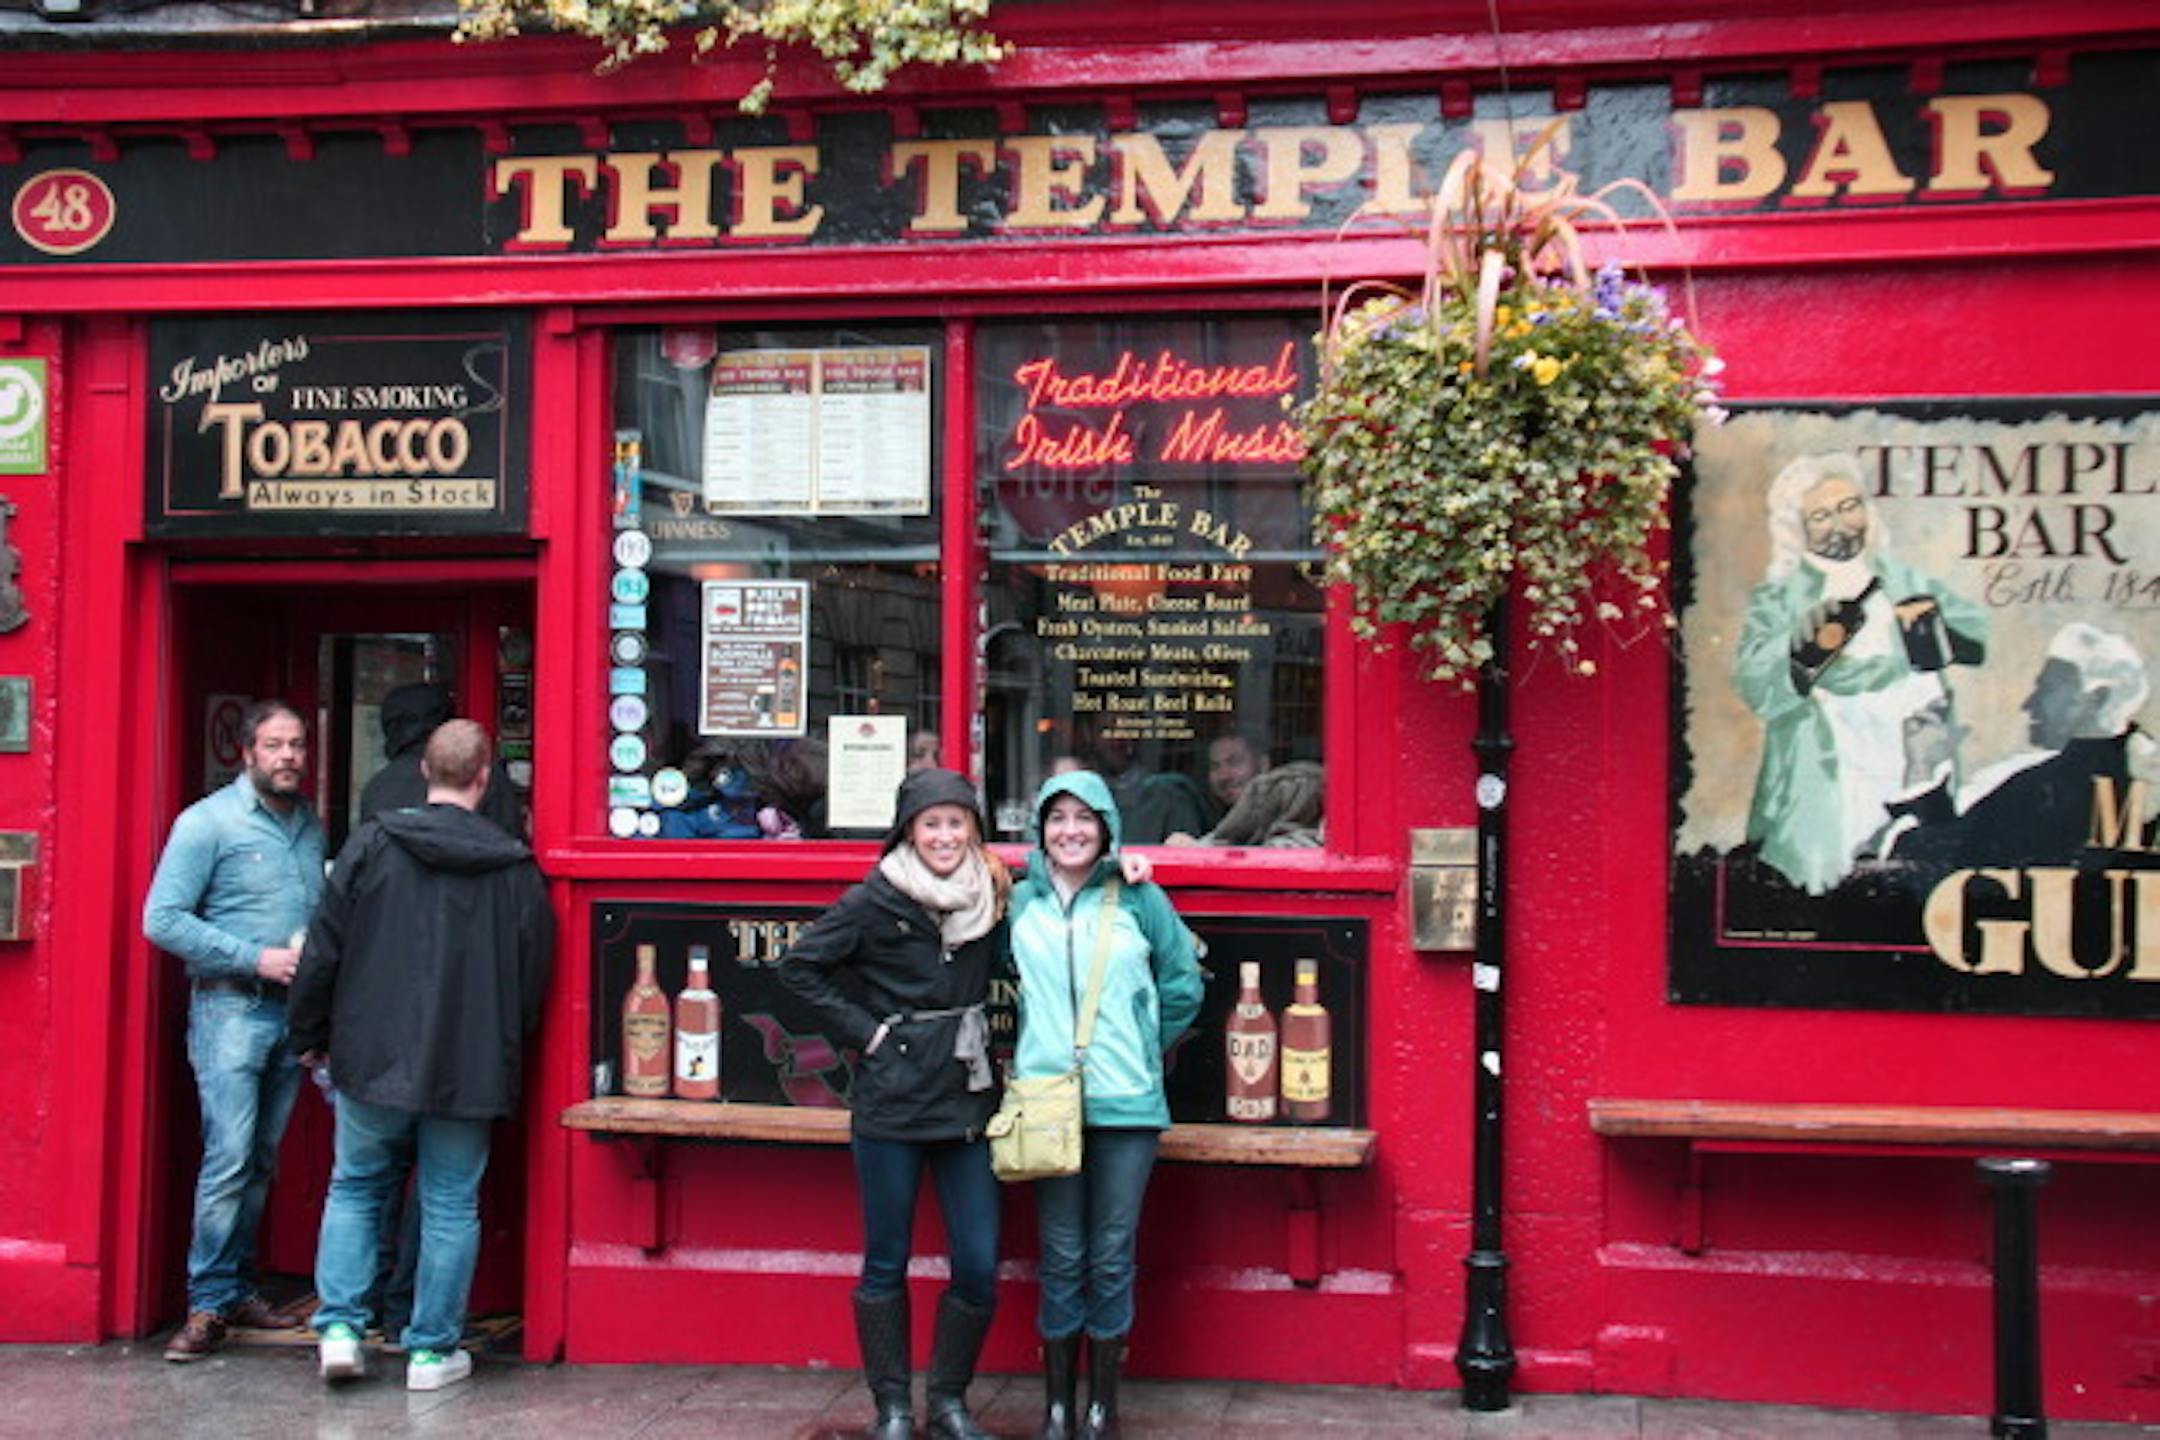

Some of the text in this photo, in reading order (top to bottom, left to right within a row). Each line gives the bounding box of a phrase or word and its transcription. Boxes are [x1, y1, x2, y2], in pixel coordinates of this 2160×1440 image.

[494, 94, 2055, 243] THE TEMPLE BAR
[29, 181, 94, 232] 48
[159, 335, 310, 402] Importers
[1013, 340, 1299, 410] Traditional
[290, 384, 469, 410] FINE SMOKING
[1005, 410, 1134, 471] Irish
[253, 480, 490, 507] Always in Stock
[1133, 485, 1162, 499] The
[648, 520, 732, 540] UINNESS
[1048, 502, 1253, 560] TEMPLE BAR
[1961, 504, 2129, 565] BAR
[1045, 563, 1252, 581] Traditional Food Fare
[2085, 775, 2160, 850] M
[728, 920, 813, 967] TH
